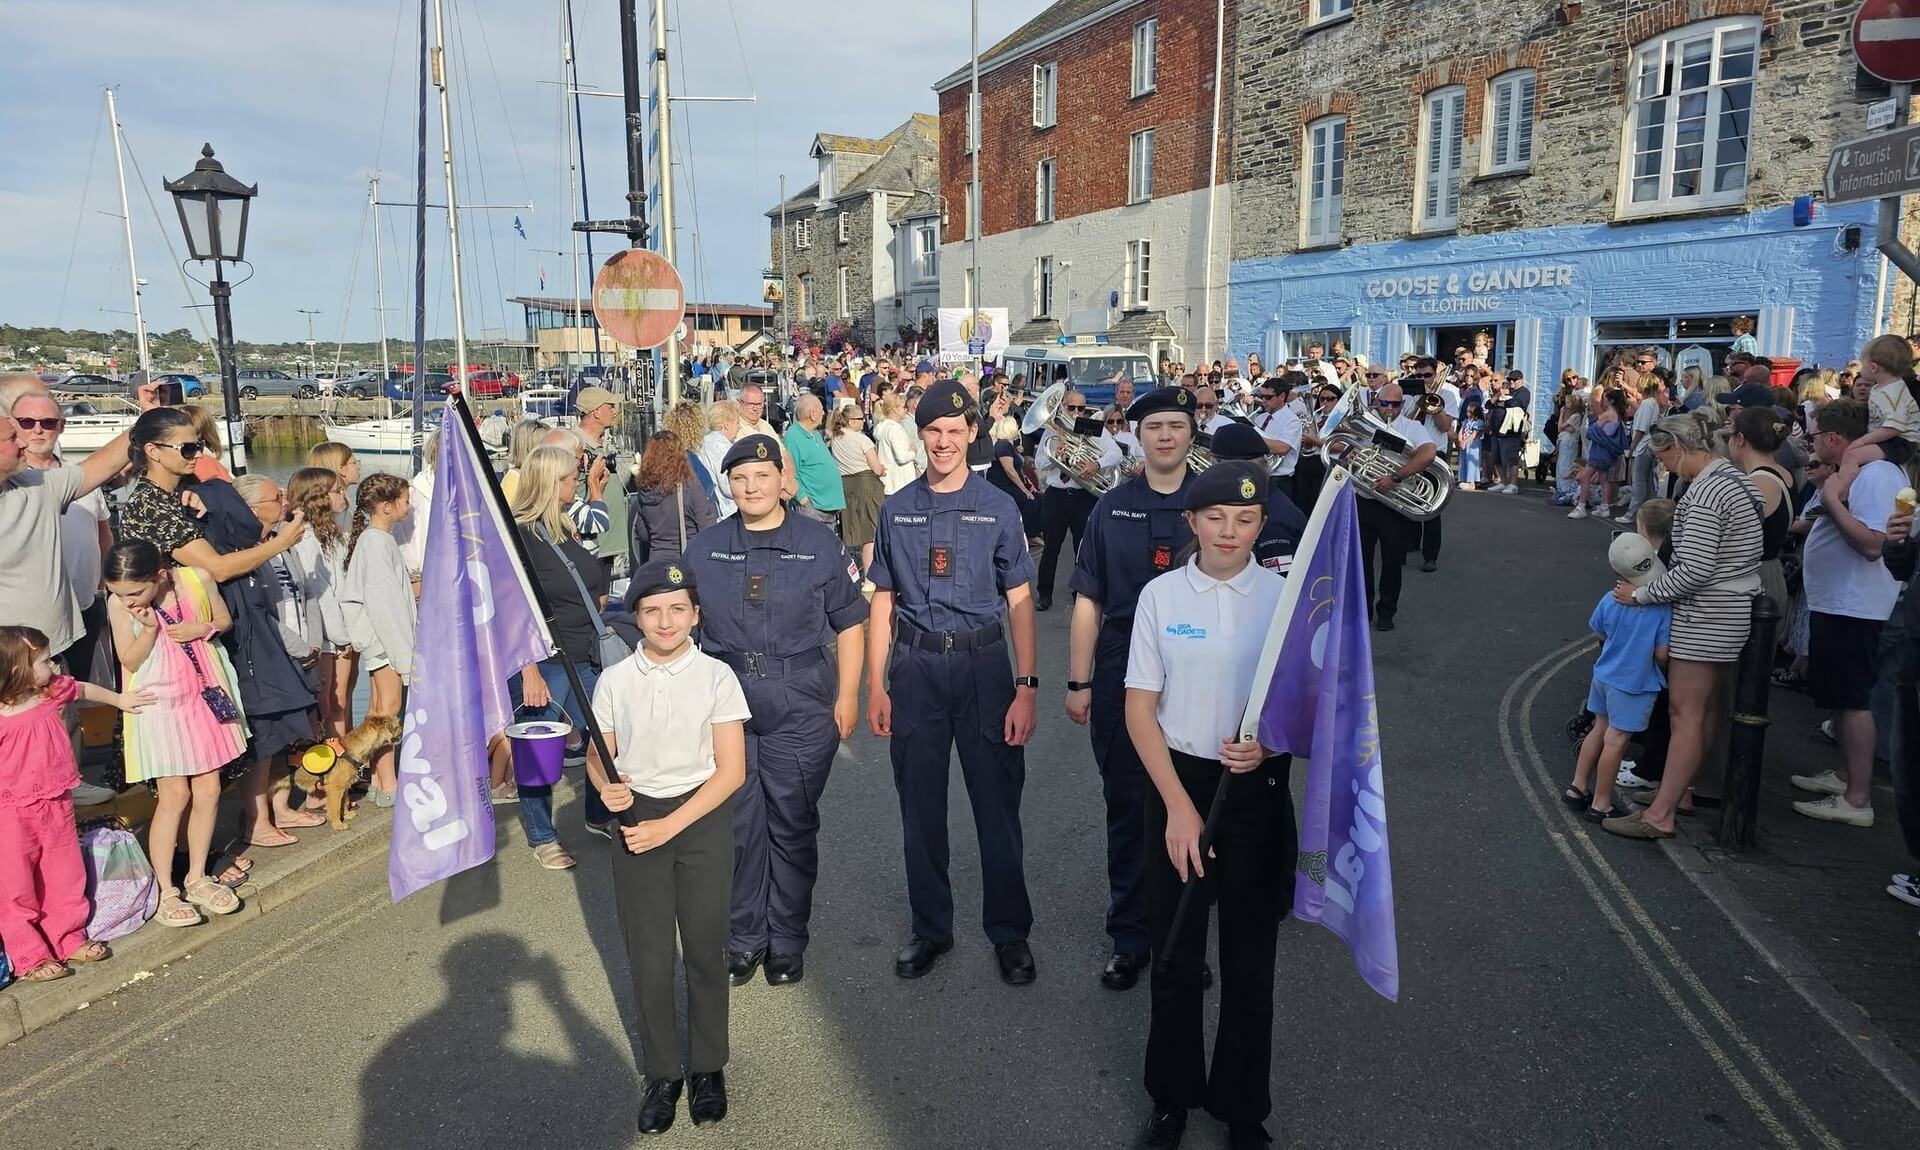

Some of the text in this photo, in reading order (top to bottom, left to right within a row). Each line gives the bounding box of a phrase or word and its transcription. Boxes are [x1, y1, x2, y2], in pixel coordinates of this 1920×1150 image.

[1854, 144, 1891, 167] Tourist
[1839, 167, 1902, 192] information
[1367, 264, 1573, 299] GOOSE & GANDER
[1422, 297, 1500, 313] CLOTHING
[711, 552, 730, 560] ROYAL
